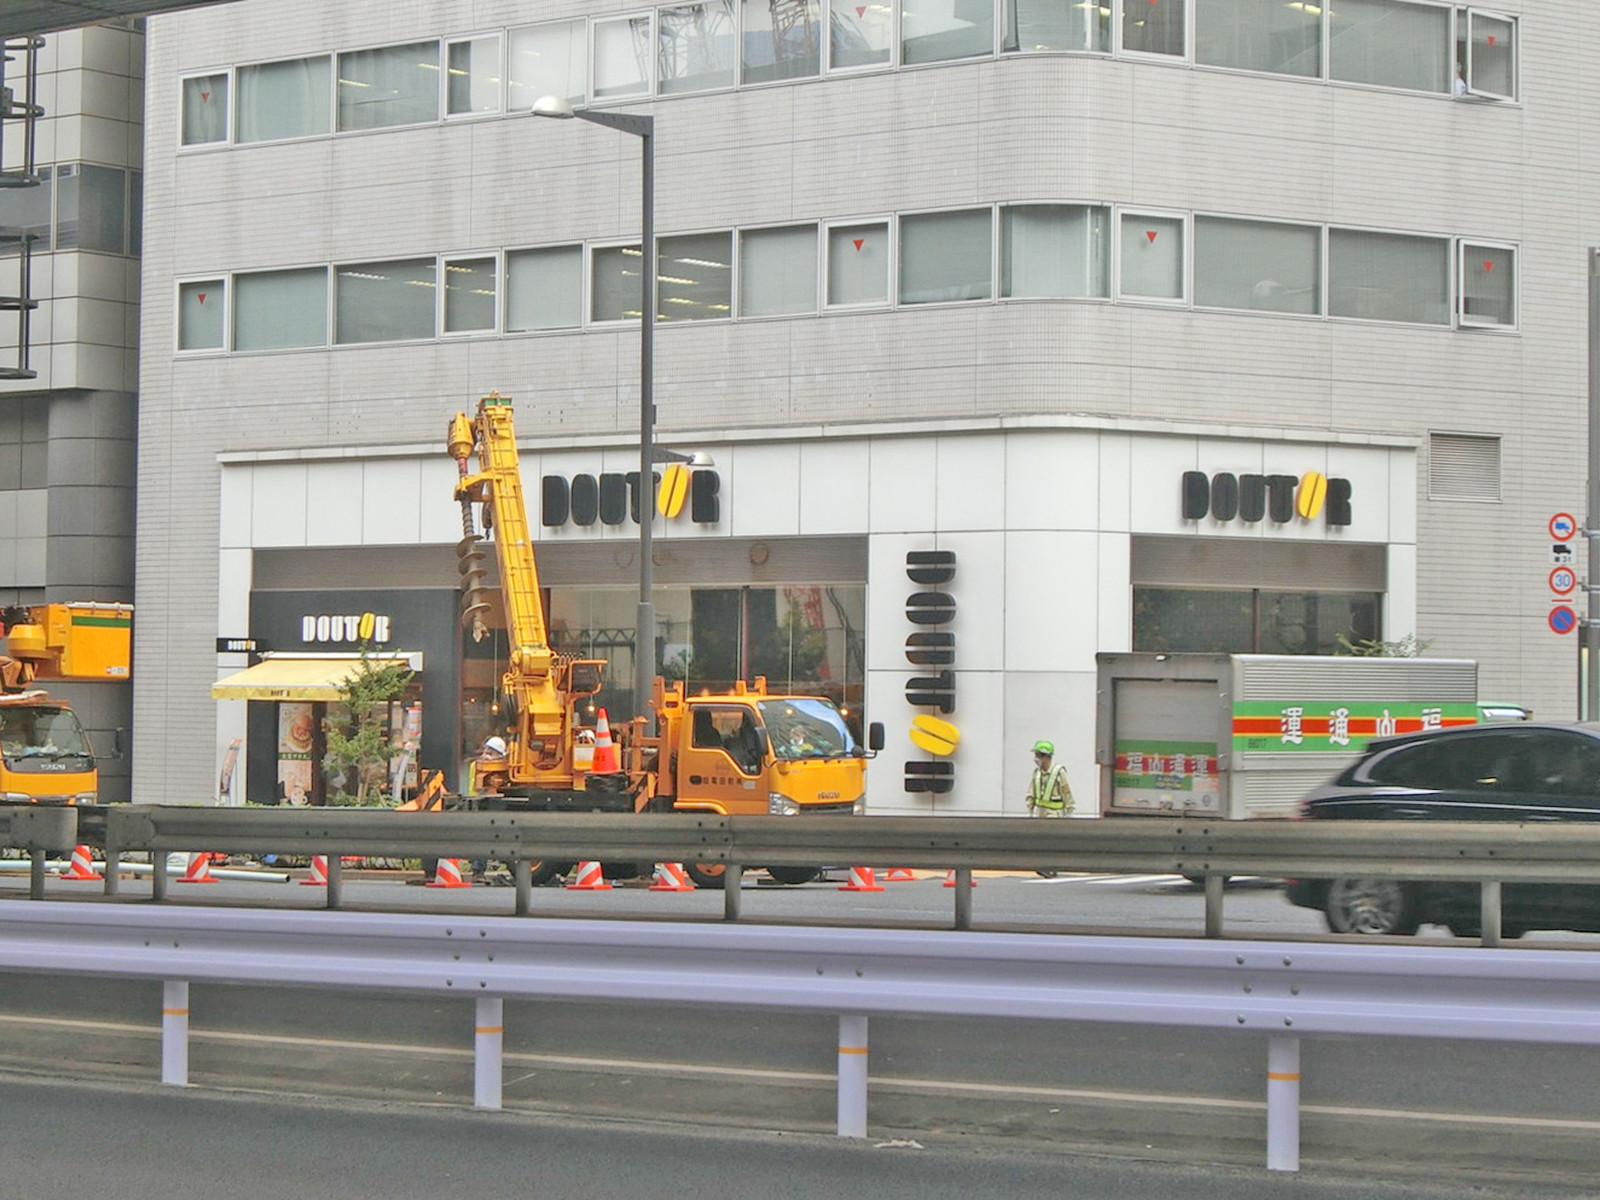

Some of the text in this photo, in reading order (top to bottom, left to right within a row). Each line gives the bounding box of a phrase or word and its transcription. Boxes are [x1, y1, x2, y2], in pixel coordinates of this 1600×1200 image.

[1182, 470, 1352, 526] DOUTOR
[1555, 574, 1571, 587] 30
[302, 612, 390, 642] DOUTOR
[905, 551, 960, 793] DOUTOR
